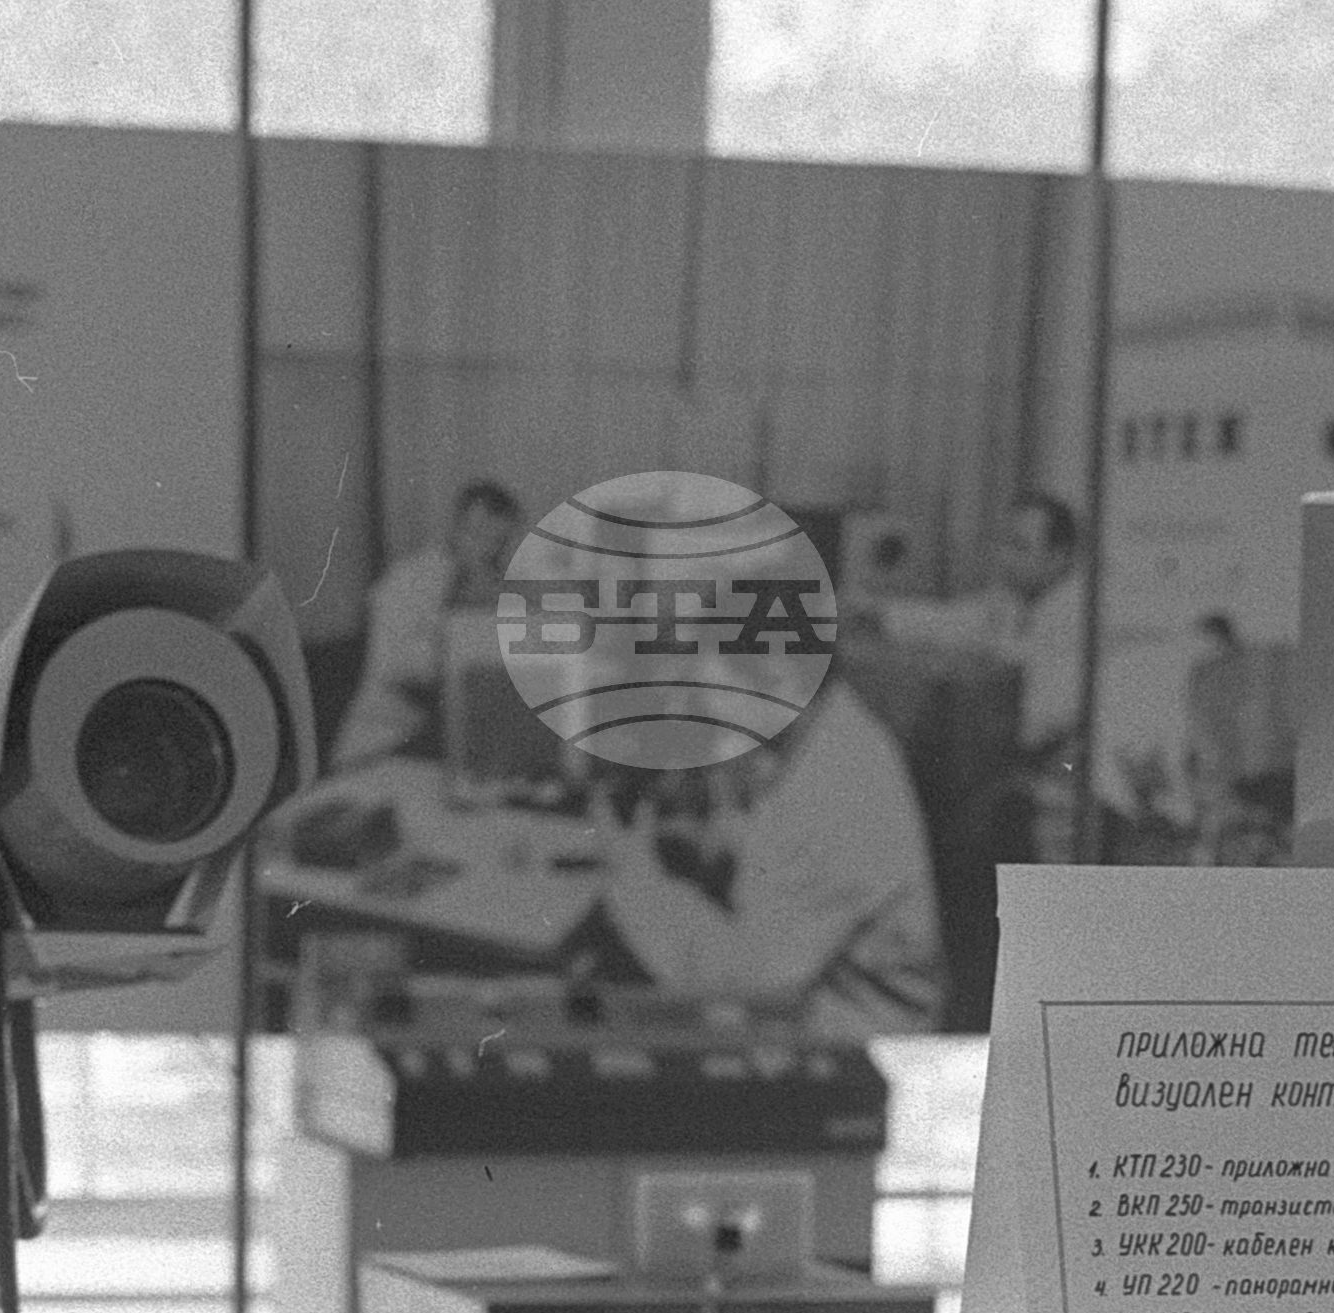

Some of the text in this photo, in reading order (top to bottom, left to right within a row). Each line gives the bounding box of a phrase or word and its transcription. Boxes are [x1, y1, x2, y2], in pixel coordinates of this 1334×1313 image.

[1116, 1030, 1266, 1059] приложна
[1115, 1072, 1254, 1113] визуален
[1220, 1158, 1331, 1183] приложна
[1222, 1231, 1315, 1257] кабелен
